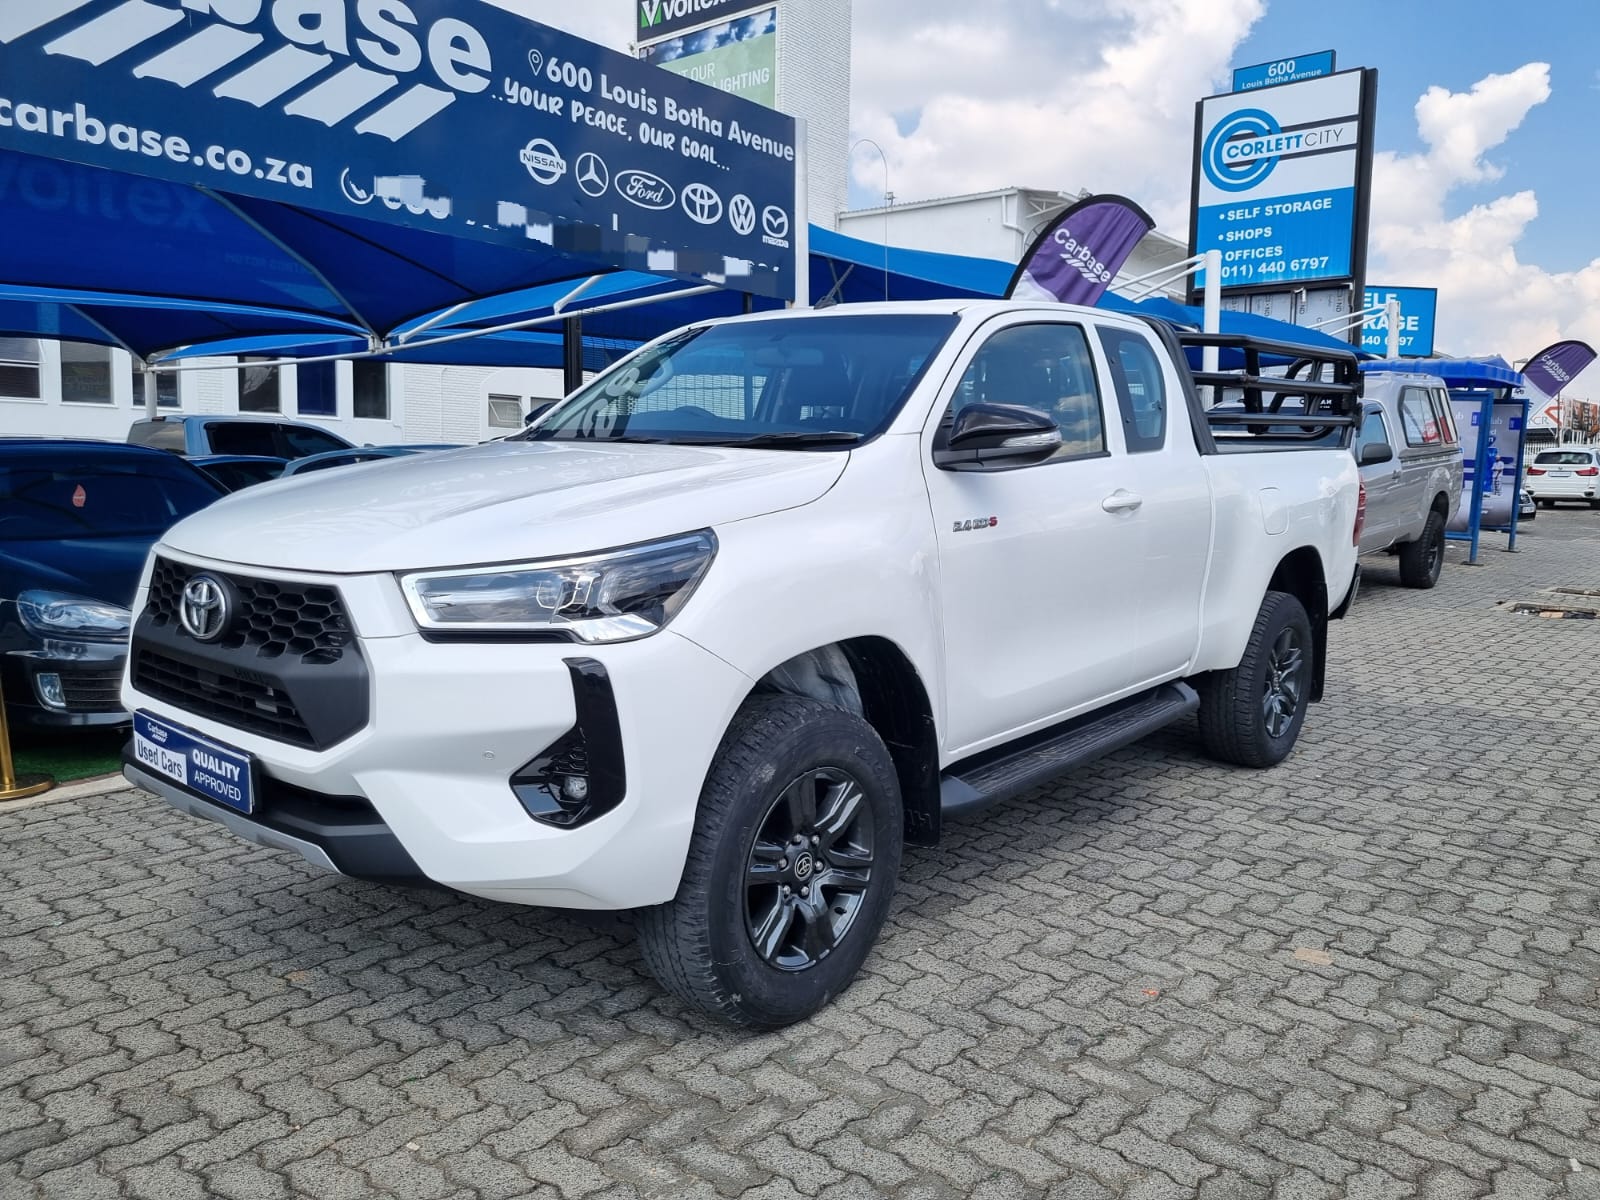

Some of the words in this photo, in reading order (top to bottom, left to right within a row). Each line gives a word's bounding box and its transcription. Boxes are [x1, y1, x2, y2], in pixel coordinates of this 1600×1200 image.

[1242, 79, 1264, 90] Louis
[1264, 75, 1290, 86] Botha
[1291, 68, 1323, 81] Avenue
[1268, 60, 1296, 77] 600
[547, 57, 593, 93] 600
[600, 74, 658, 116] Louis
[664, 97, 723, 137] Botha
[728, 121, 794, 162] Avenue
[521, 150, 566, 171] NISSAN
[626, 173, 663, 204] Ford
[1226, 207, 1261, 221] SELF
[1264, 198, 1332, 217] STORAGE
[1226, 227, 1273, 242] SHOPS
[1054, 228, 1111, 282] Carbase
[1225, 245, 1283, 262] OFFICES
[1222, 263, 1254, 279] 011)
[1258, 259, 1287, 275] 440
[1292, 256, 1329, 271] 6797
[1363, 292, 1398, 308] ELF
[1541, 354, 1570, 382] Carbase
[138, 739, 159, 766] Used
[161, 751, 183, 778] Cars
[193, 749, 241, 781] QUALITY
[194, 770, 242, 801] APPROVED
